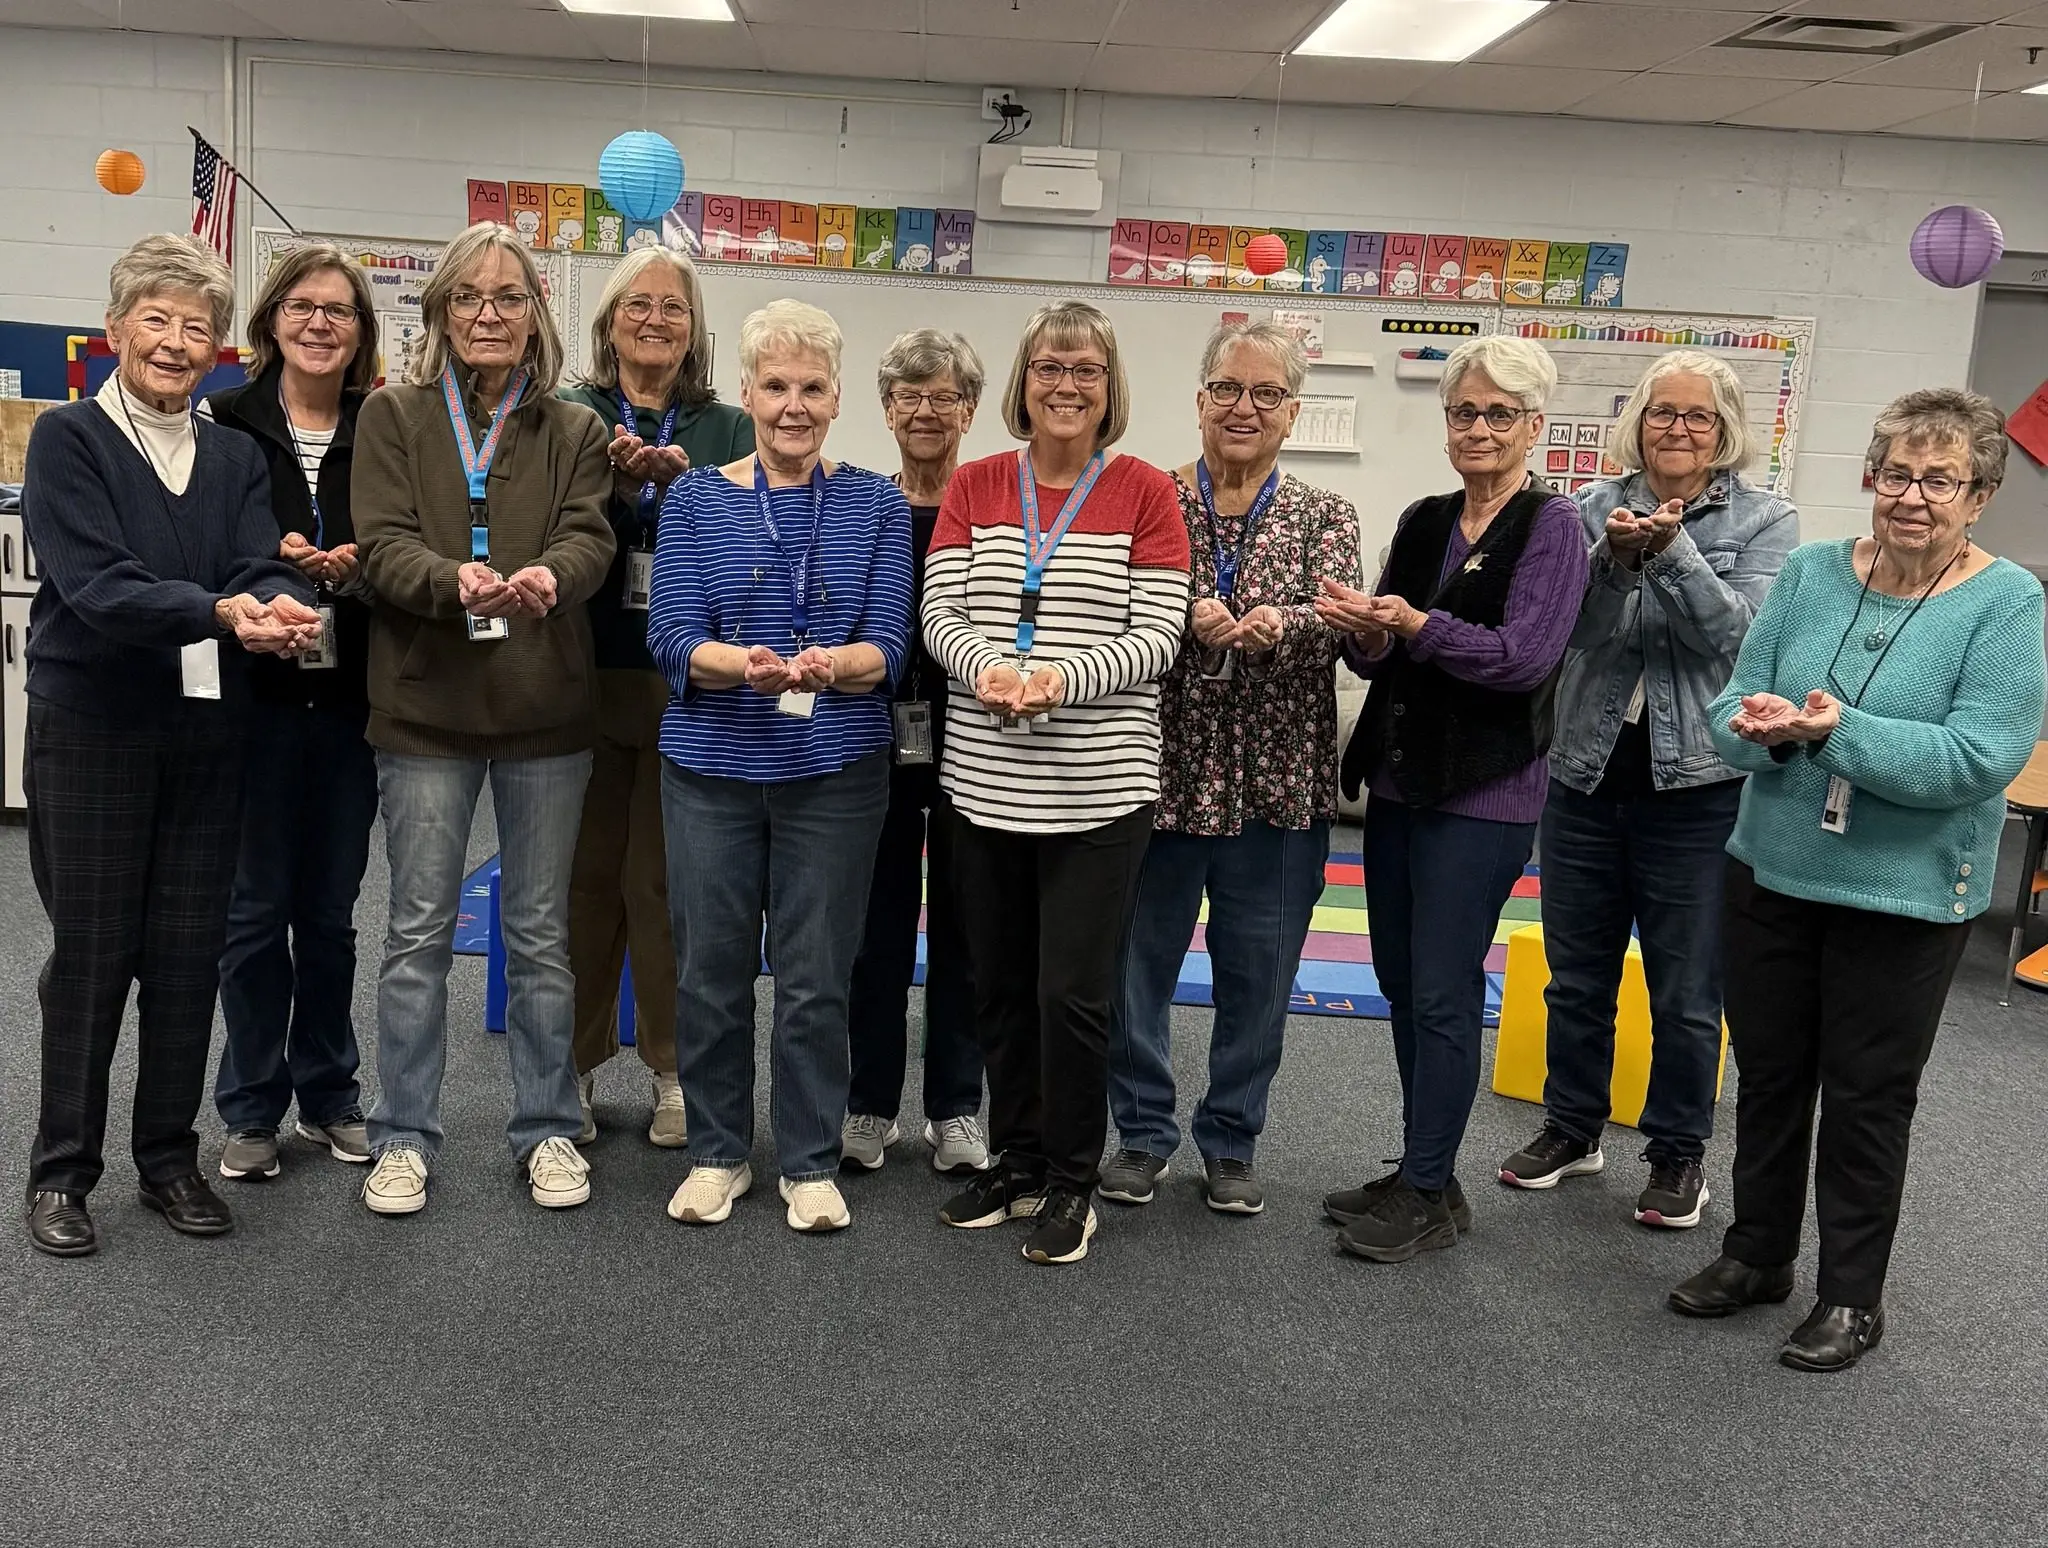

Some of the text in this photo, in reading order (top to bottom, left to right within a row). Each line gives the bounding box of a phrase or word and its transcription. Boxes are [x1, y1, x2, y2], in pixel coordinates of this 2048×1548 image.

[474, 184, 499, 203] Aa
[516, 186, 539, 205] Bb
[553, 188, 576, 207] Cc
[709, 198, 734, 223] Gg
[747, 202, 771, 221] Hh
[790, 205, 803, 224] Ii
[824, 207, 845, 231] Jj
[865, 211, 887, 229] Kk
[908, 211, 922, 230] Ll
[937, 213, 972, 233] Mm
[1118, 223, 1141, 243] Nn
[1155, 225, 1181, 244] Oo
[1197, 228, 1220, 251] Pp
[1316, 234, 1335, 253] Ss
[1354, 235, 1376, 254] Tt
[1392, 236, 1415, 256] Uu
[1433, 238, 1457, 257] Vv
[1473, 241, 1505, 258] Ww
[1515, 243, 1540, 263] Xx
[1556, 245, 1581, 270] Yy
[1594, 246, 1618, 266] Zz
[1551, 428, 1568, 441] SUN
[1579, 429, 1597, 442] MON
[1582, 456, 1590, 469] 2
[646, 488, 653, 499] GO
[760, 491, 768, 502] GO
[1262, 486, 1272, 497] GO
[796, 592, 805, 605] GO
